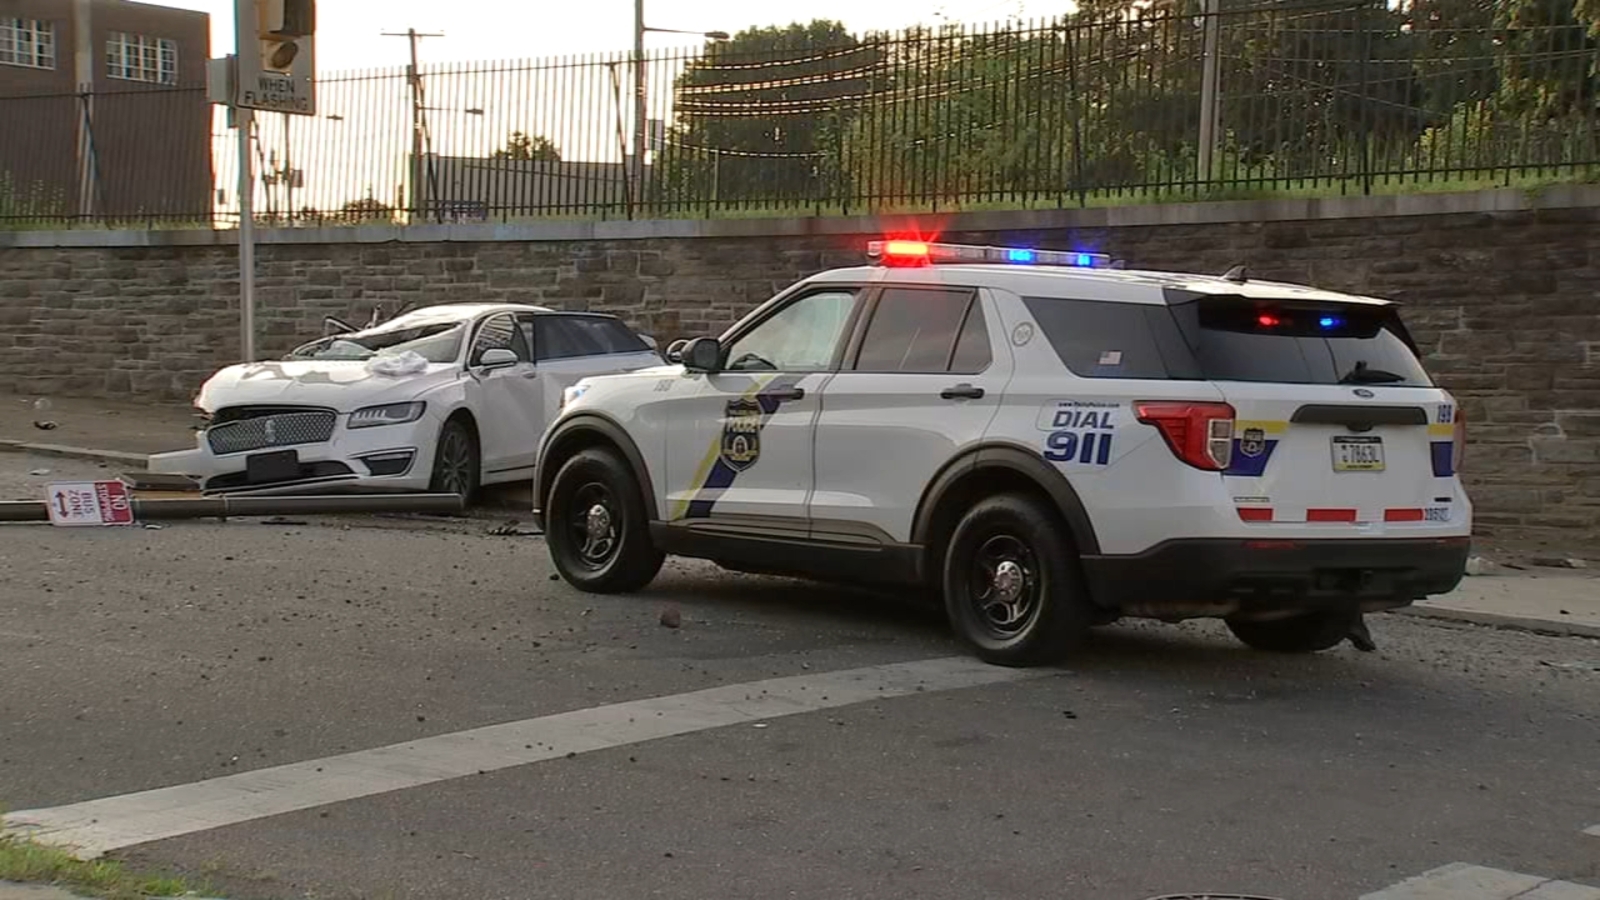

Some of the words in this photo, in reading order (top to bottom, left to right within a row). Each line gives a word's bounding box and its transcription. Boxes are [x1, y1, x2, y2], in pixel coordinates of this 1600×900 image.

[258, 77, 295, 93] WHEN
[1052, 410, 1115, 429] DIAL
[1043, 430, 1113, 465] 911
[110, 494, 127, 511] NO
